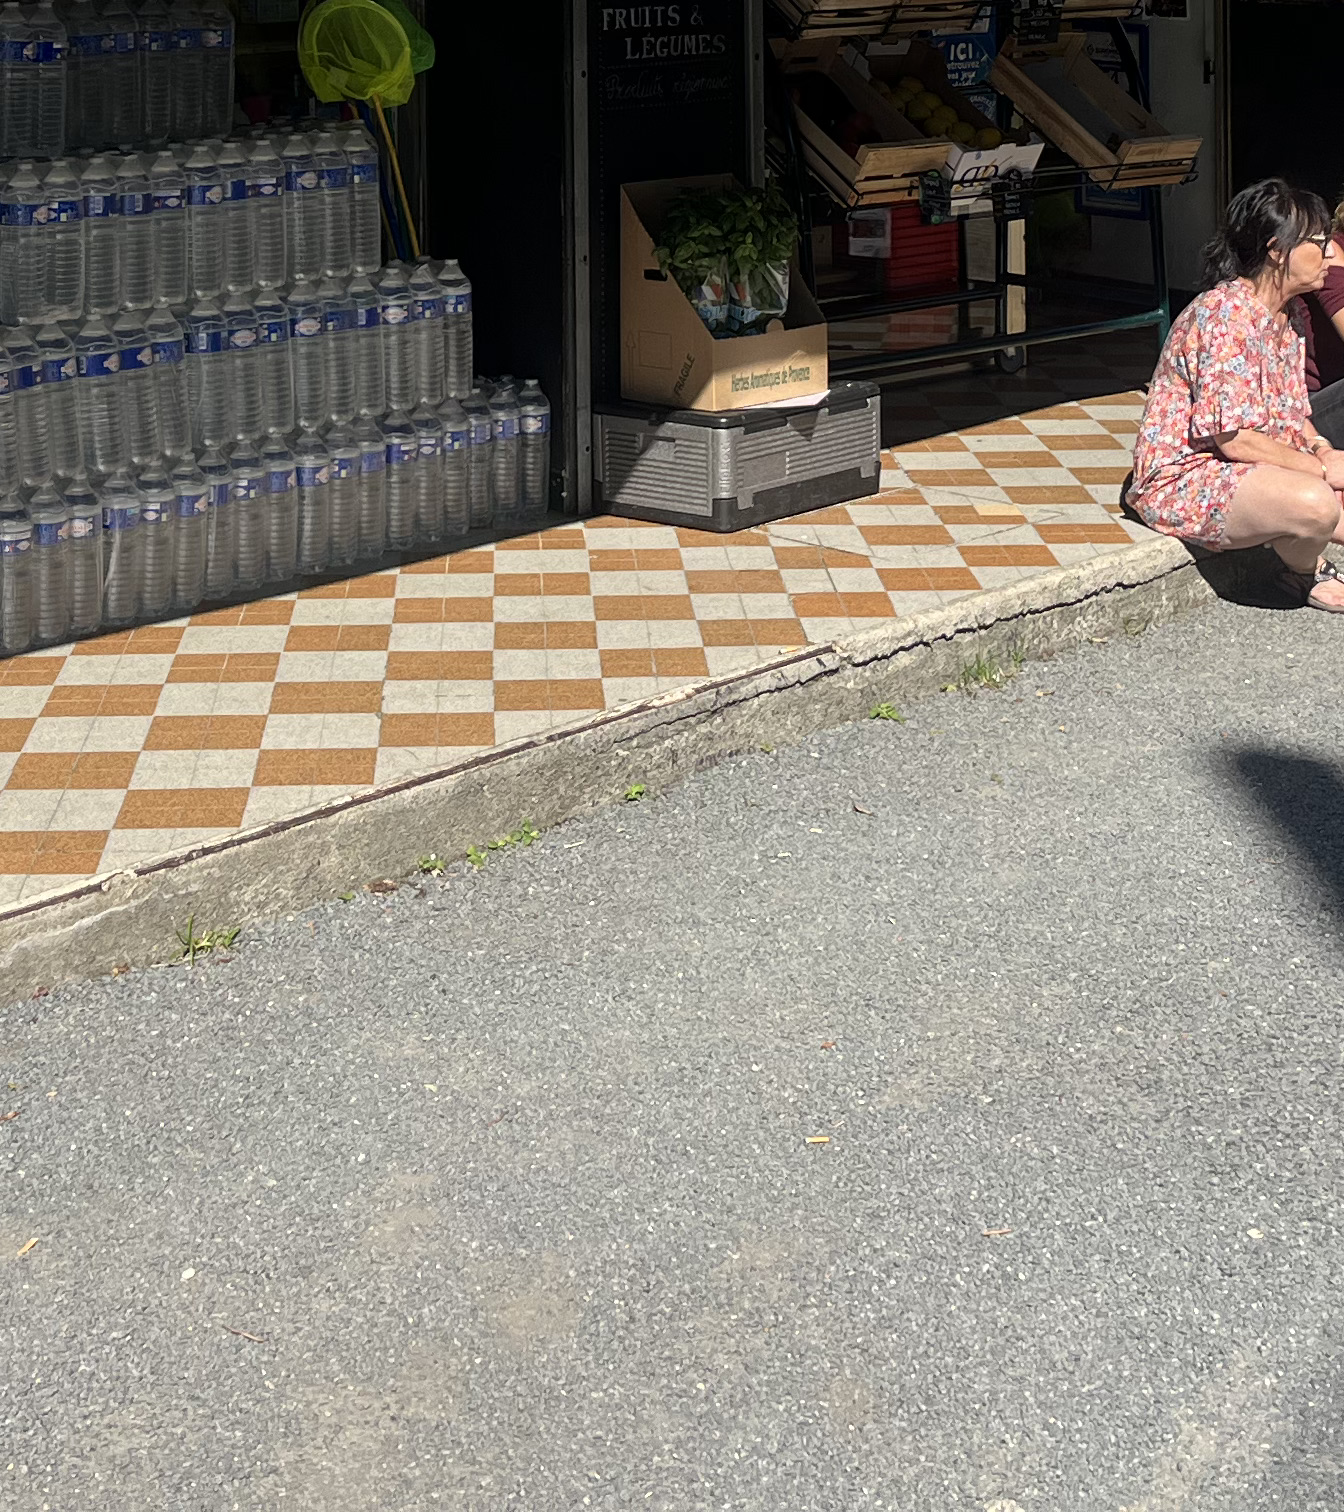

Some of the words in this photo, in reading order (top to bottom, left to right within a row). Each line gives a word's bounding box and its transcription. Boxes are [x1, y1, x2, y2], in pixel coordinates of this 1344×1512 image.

[601, 4, 681, 31] FRUITS
[690, 4, 704, 26] &
[625, 32, 727, 60] LÉGUMES
[950, 42, 973, 61] ICI
[673, 352, 696, 397] FRAGILE
